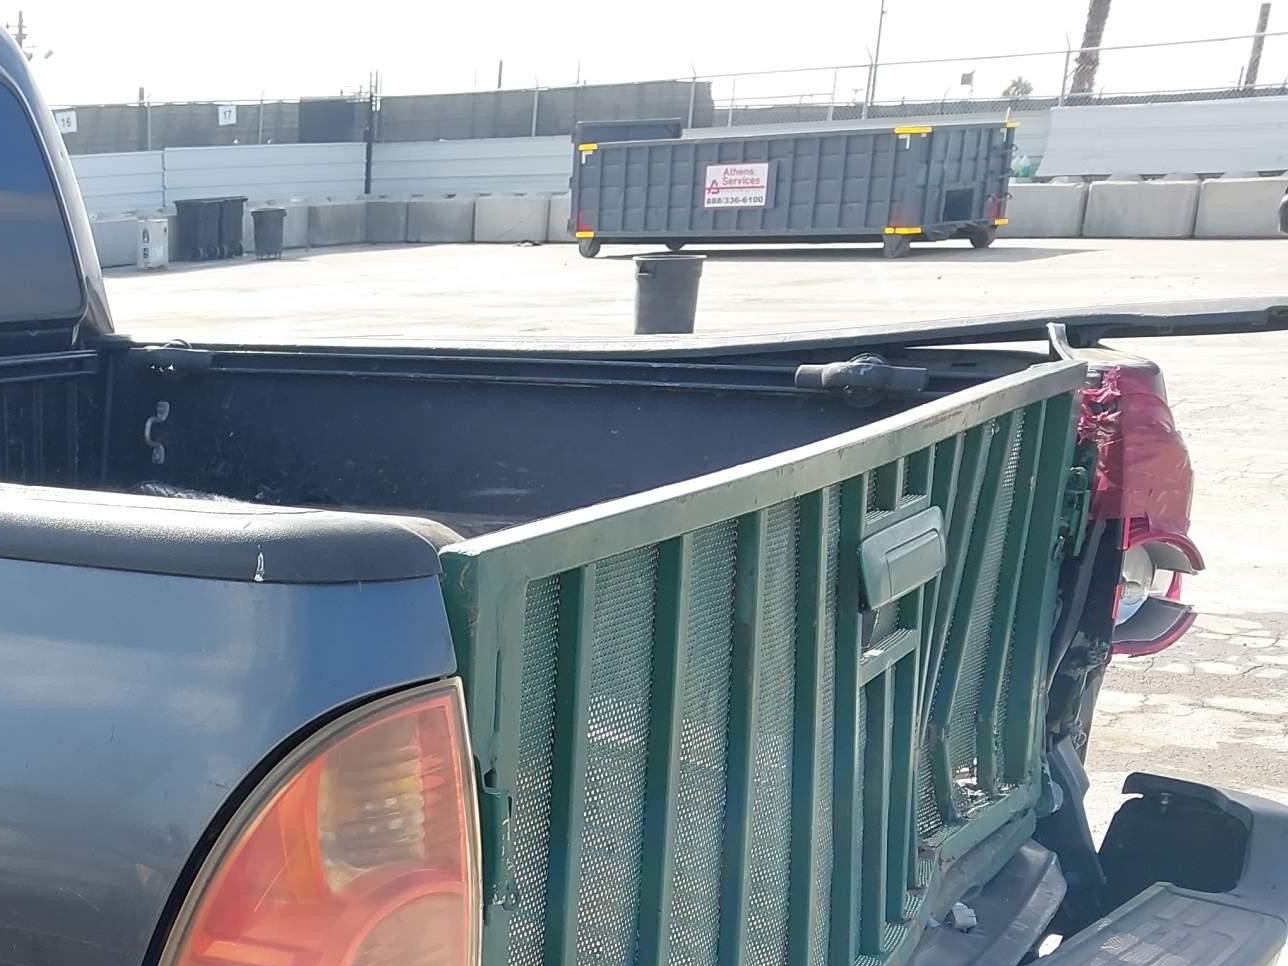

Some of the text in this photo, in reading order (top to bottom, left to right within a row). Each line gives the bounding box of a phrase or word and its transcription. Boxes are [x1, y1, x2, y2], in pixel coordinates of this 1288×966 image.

[223, 110, 232, 120] 17
[723, 167, 754, 176] Athens
[722, 175, 761, 185] Services
